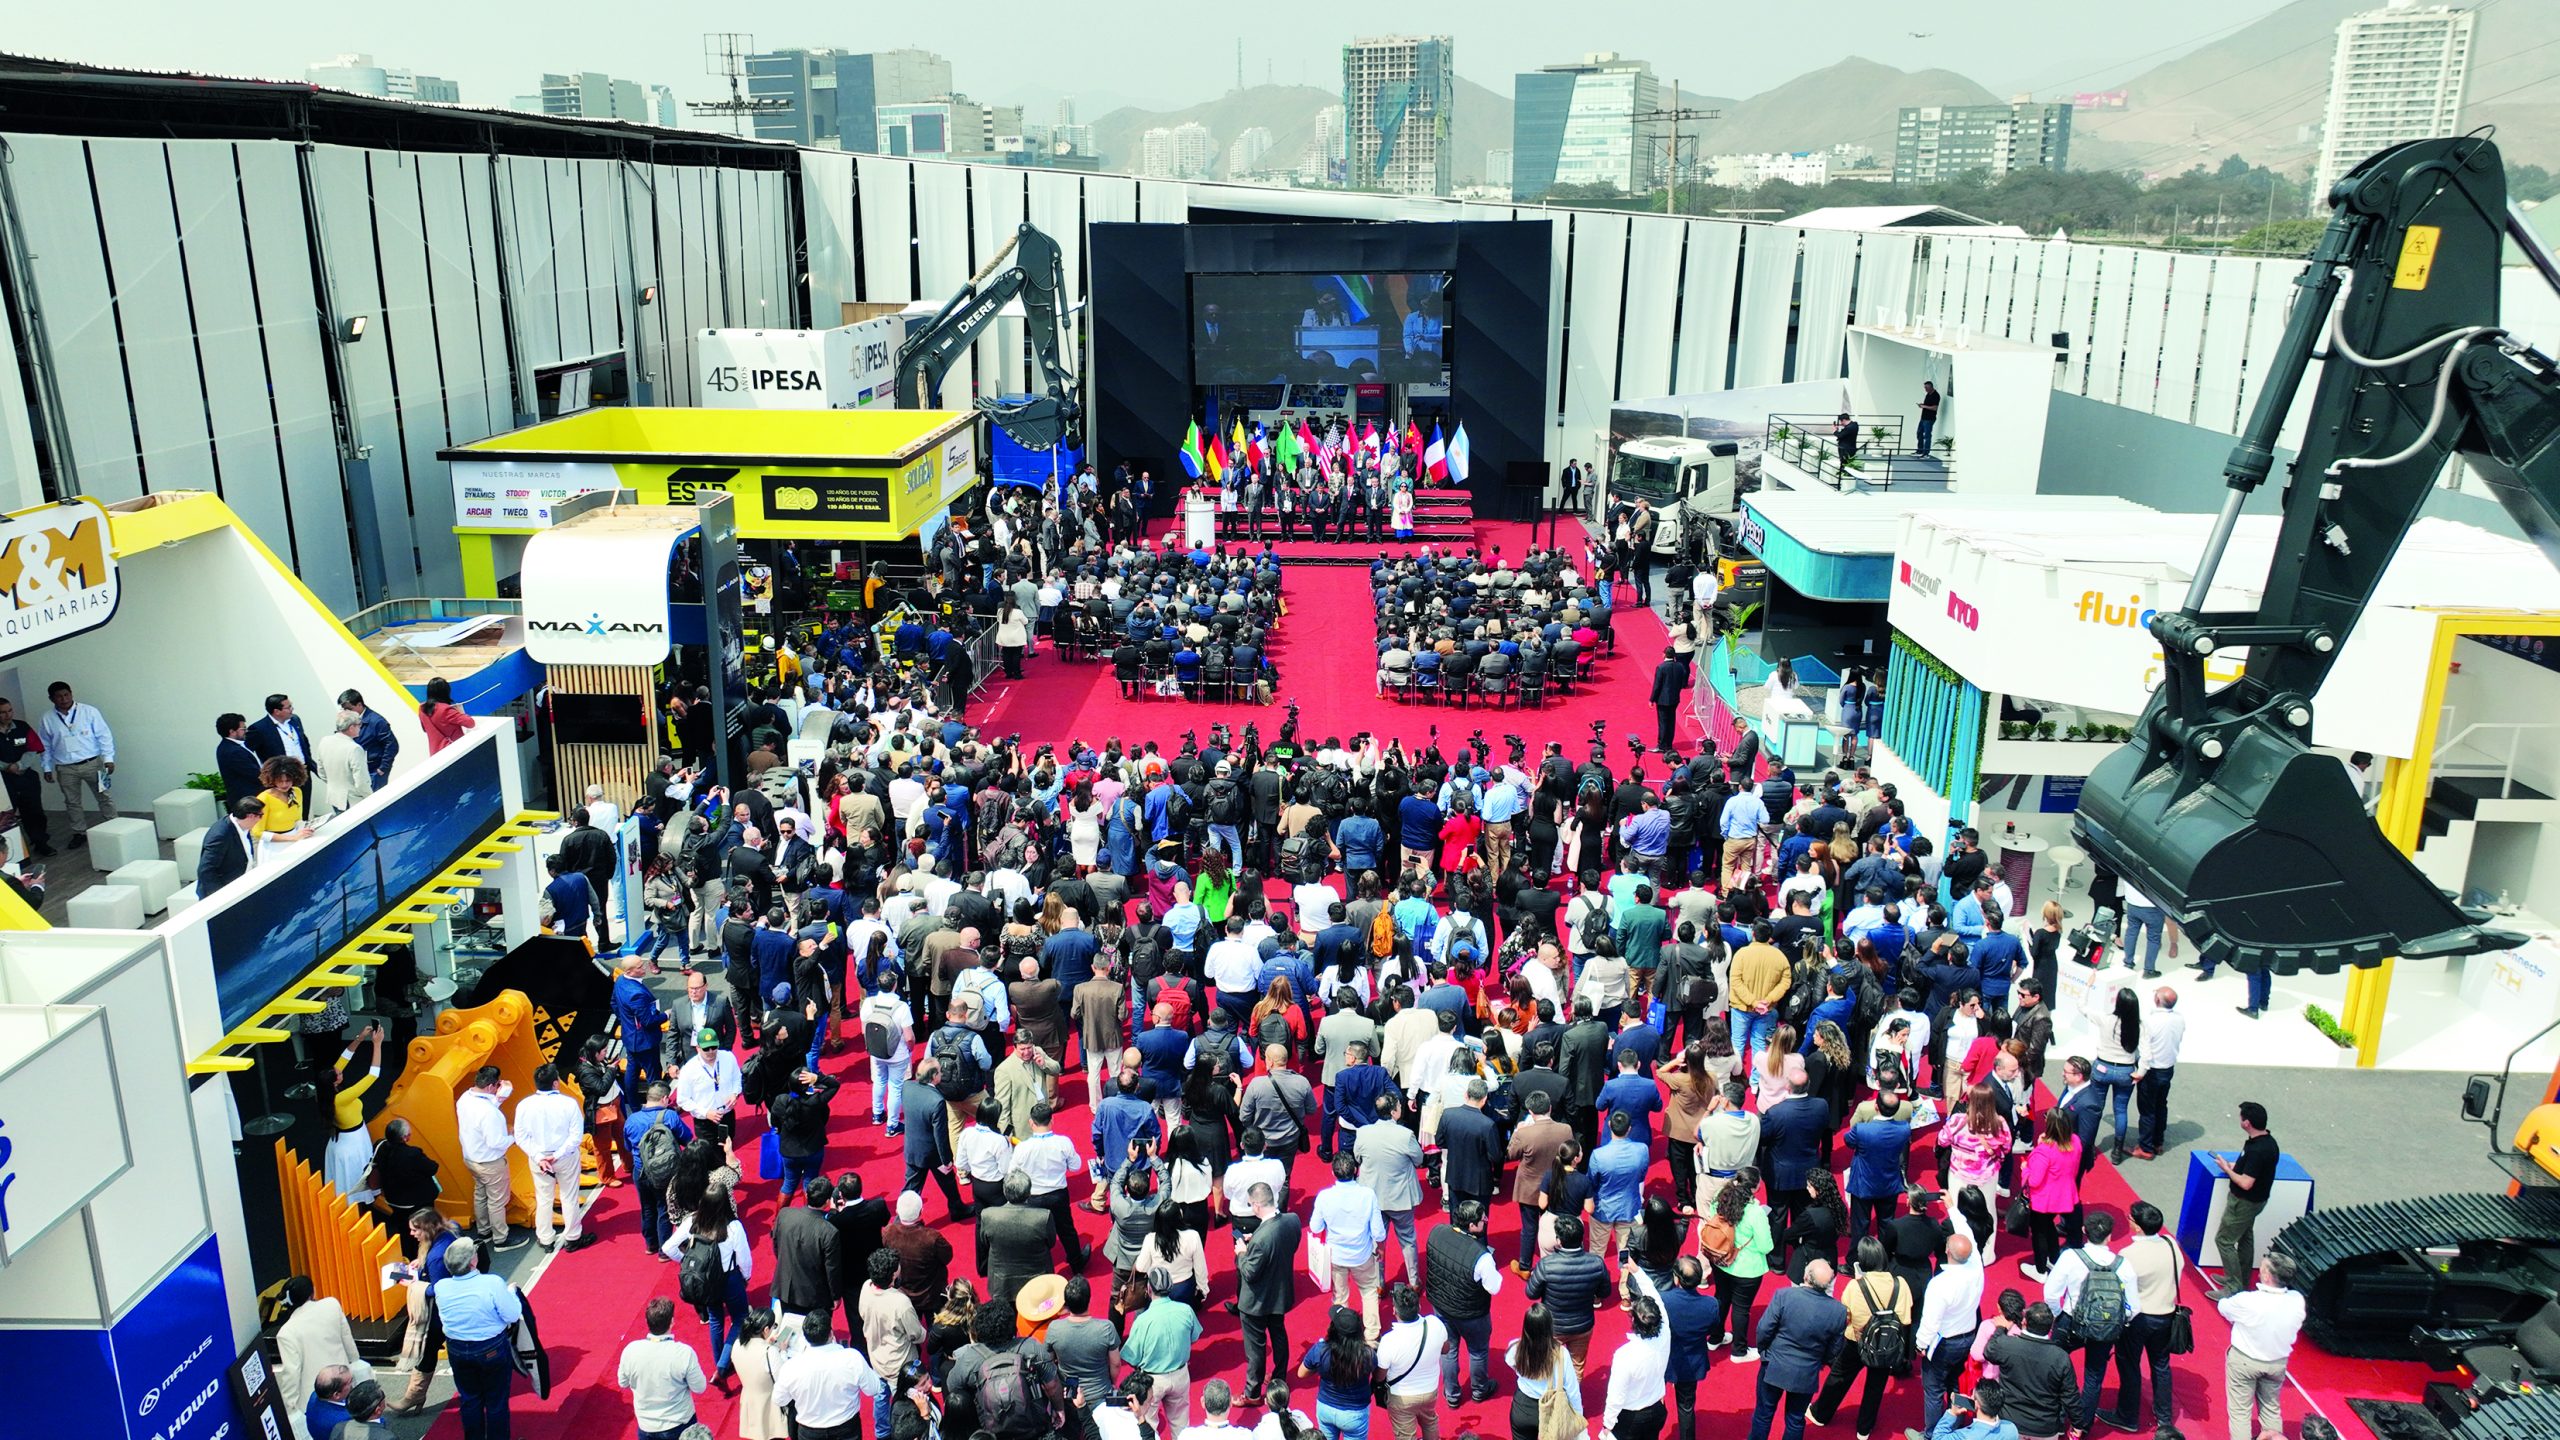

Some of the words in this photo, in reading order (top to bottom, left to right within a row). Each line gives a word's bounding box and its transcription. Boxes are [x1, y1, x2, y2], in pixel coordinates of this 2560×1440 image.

[957, 298, 996, 334] DEERE
[1876, 305, 1970, 349] VOLVO
[864, 341, 889, 373] IPESA
[707, 366, 739, 392] 45
[741, 366, 750, 392] AÑOS
[752, 370, 822, 390] IPESA
[465, 491, 496, 499] DYNAMICS
[505, 490, 531, 498] STOODY
[540, 490, 567, 498] VICTOR
[466, 508, 492, 516] ARCAIR
[503, 508, 529, 517] TWECO
[0, 589, 110, 638] QUINARIAS
[1947, 590, 1979, 632] RYCO
[528, 615, 663, 635] MAXAM
[1275, 747, 1294, 755] MCM
[162, 1335, 213, 1391] MAXUS
[168, 1378, 219, 1440] HOWO
